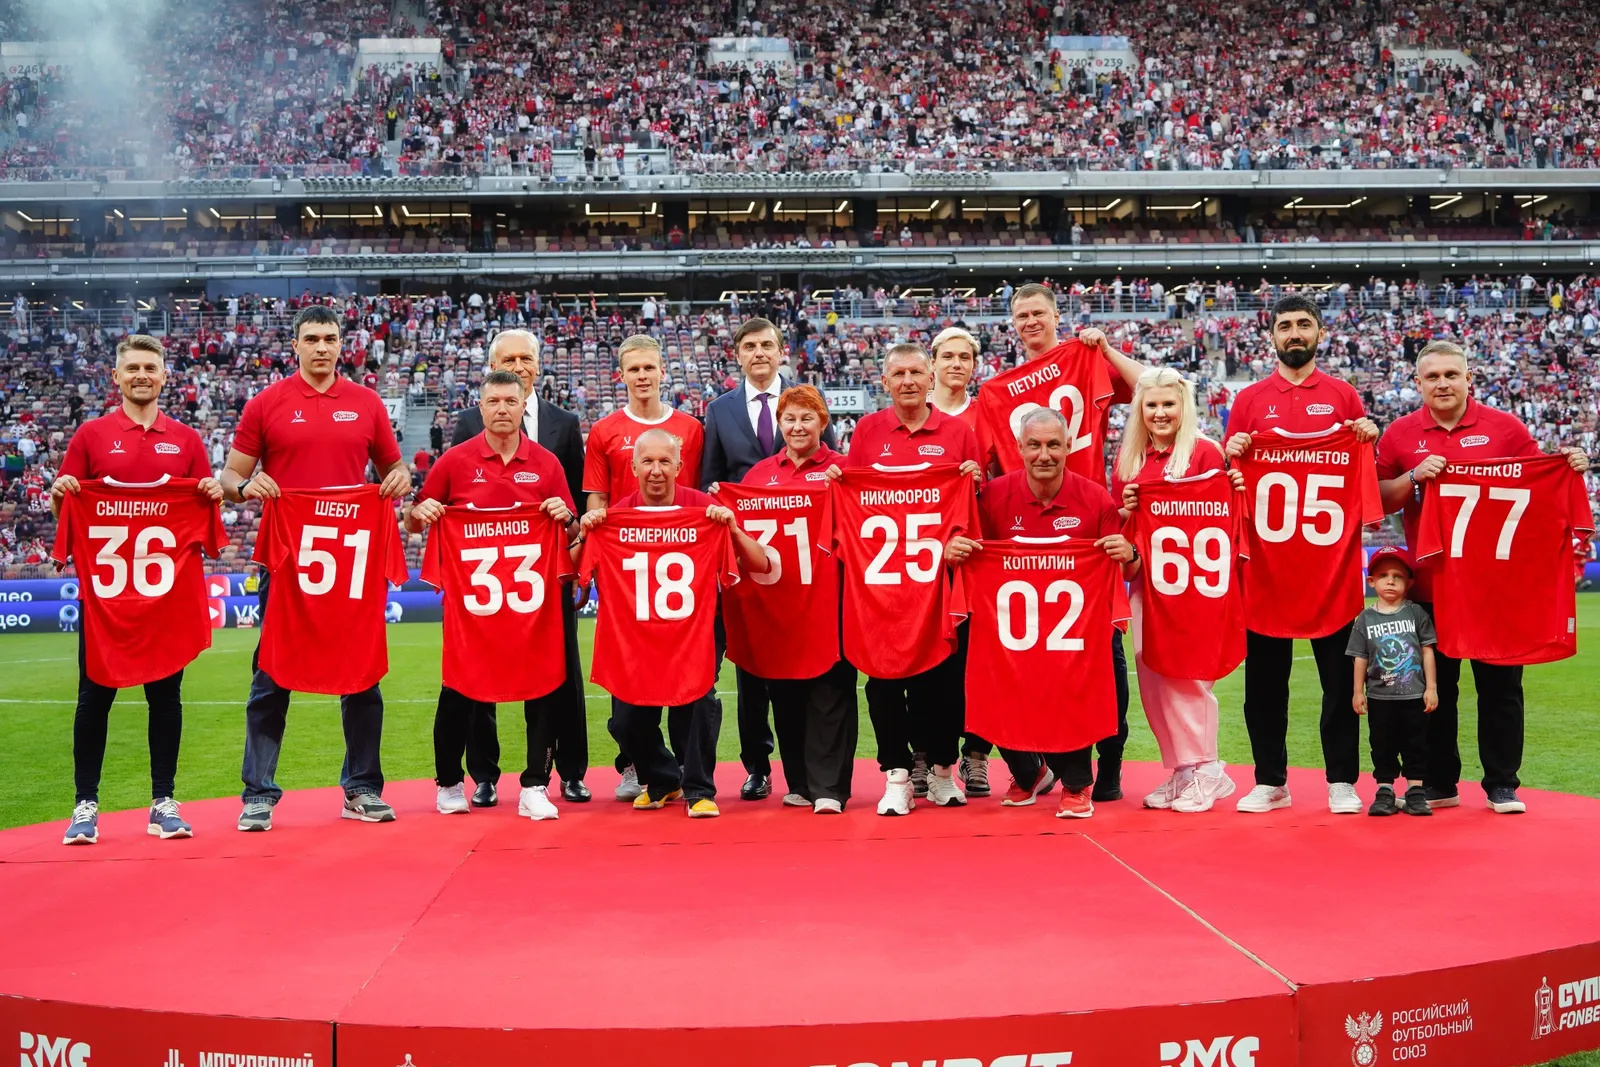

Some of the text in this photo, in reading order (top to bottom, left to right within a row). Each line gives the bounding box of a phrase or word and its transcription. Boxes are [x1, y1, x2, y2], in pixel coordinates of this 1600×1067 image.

[17, 64, 38, 74] 246
[1068, 58, 1087, 68] 240
[1104, 58, 1123, 68] 239
[1007, 363, 1061, 397] ПЕТУХОВ
[834, 395, 857, 407] 135
[1254, 449, 1350, 465] ГАДЖИМЕТОВ
[736, 494, 813, 511] ЗВЯГИНЦЕВА
[860, 488, 941, 506] НИКИФОРОВ
[96, 500, 169, 519] СЫЩЕНКО
[314, 500, 361, 519] ШЕБУТ
[1150, 500, 1230, 517] ФИЛИППОВА
[1254, 471, 1345, 546] 05
[463, 520, 530, 539] ШИБАНОВ
[1439, 484, 1531, 560] 77
[619, 527, 697, 543] СЕМЕРИКОВ
[743, 516, 813, 585] 31
[860, 513, 943, 585] 25
[88, 525, 177, 599] 36
[297, 524, 371, 600] 51
[1003, 555, 1075, 570] КОПТИЛИН
[1150, 526, 1231, 599] 69
[460, 543, 545, 616] 33
[622, 551, 695, 621] 18
[996, 579, 1085, 651] 02
[1366, 619, 1417, 640] FREEDOM
[1558, 976, 1600, 1009] СУП
[1392, 998, 1469, 1026] РОССИЙСКИЙ
[1392, 1015, 1473, 1043] ФУТБОЛЬНЫЙ
[1392, 1043, 1427, 1061] СОЮЗ
